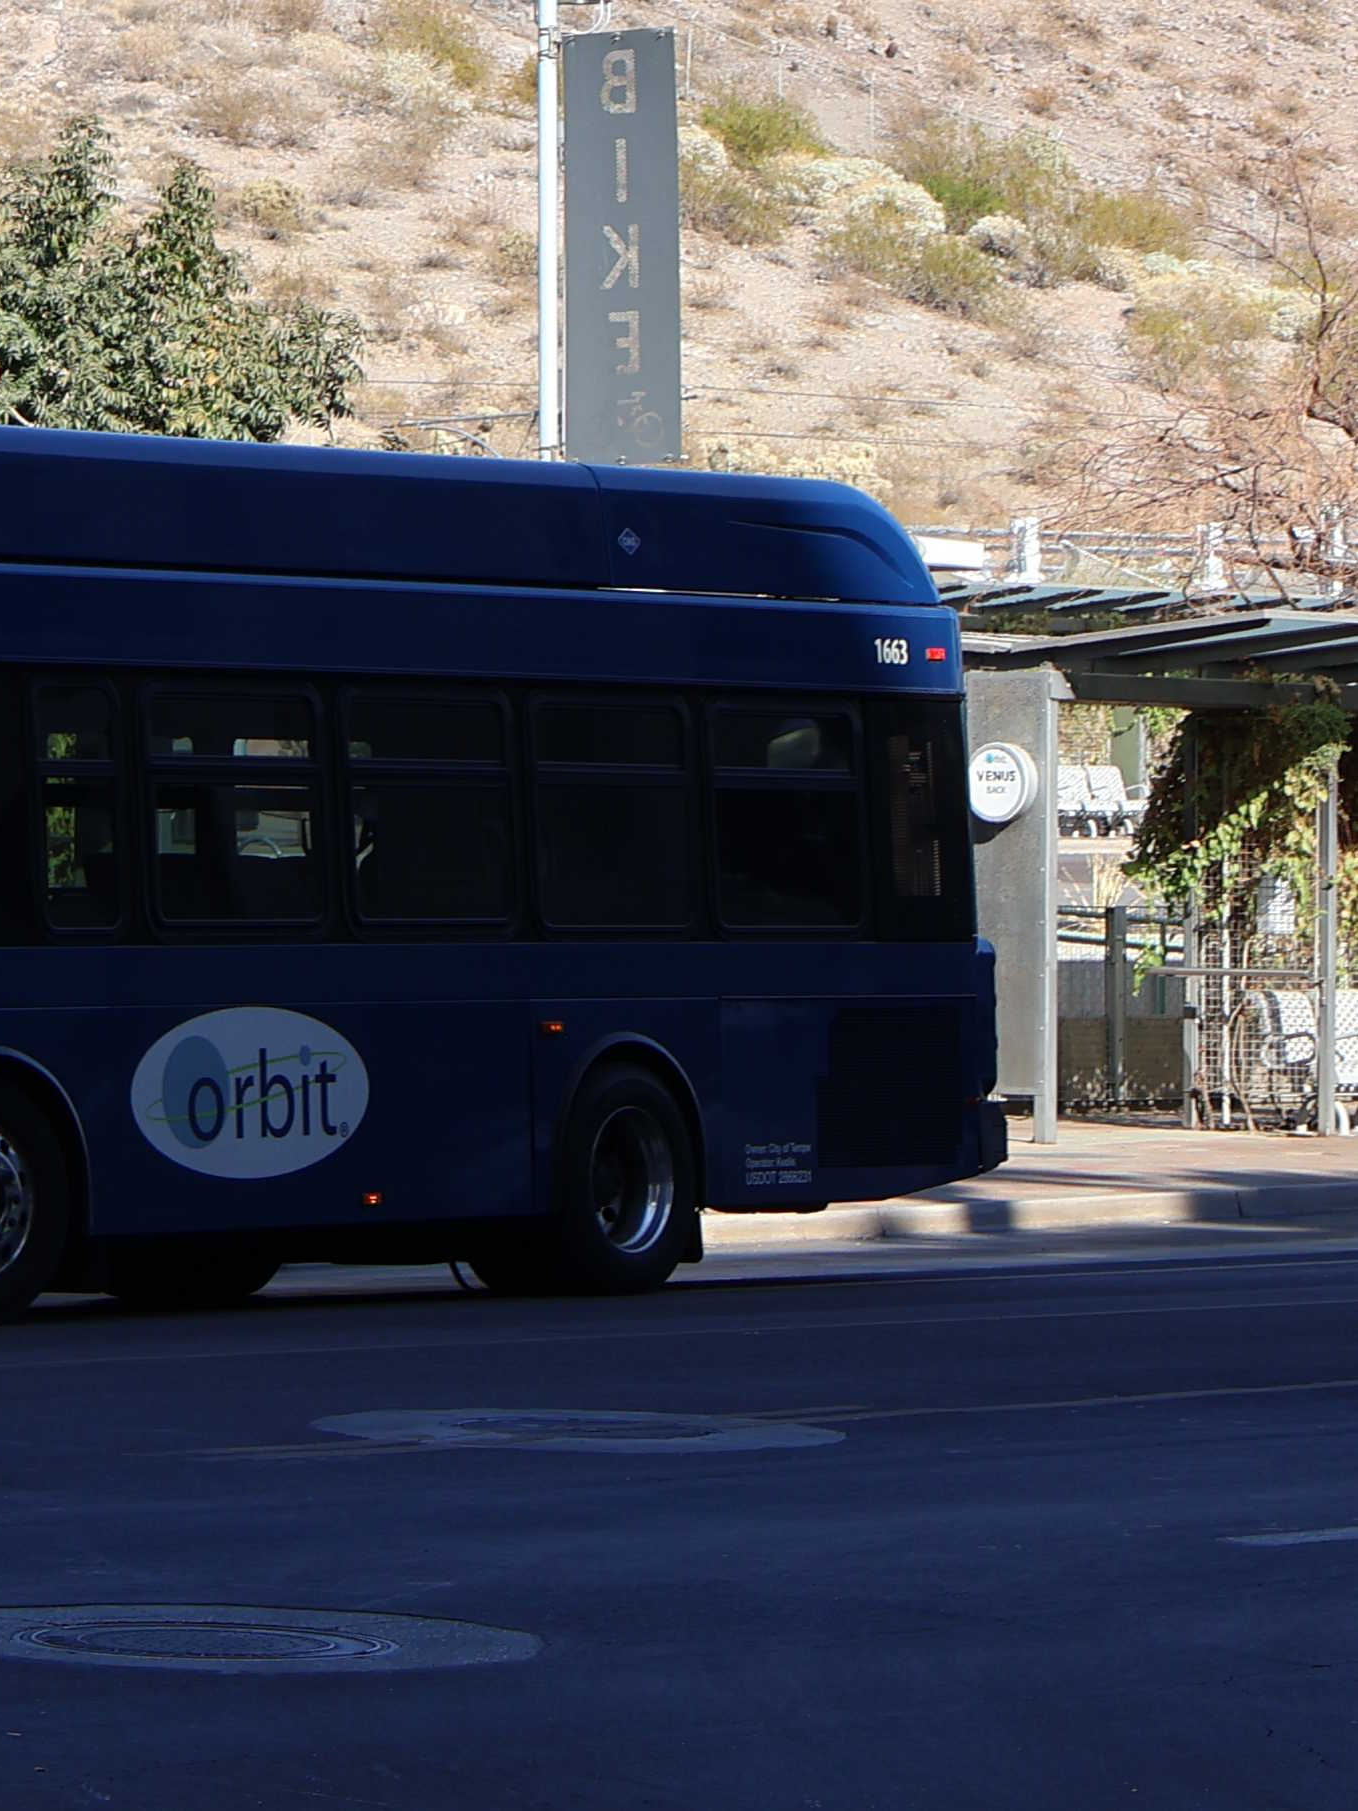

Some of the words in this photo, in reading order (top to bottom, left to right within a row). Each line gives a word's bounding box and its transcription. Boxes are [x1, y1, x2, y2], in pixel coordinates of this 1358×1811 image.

[873, 637, 910, 666] 1663
[976, 769, 1017, 783] VENUS
[188, 1044, 338, 1141] orbit
